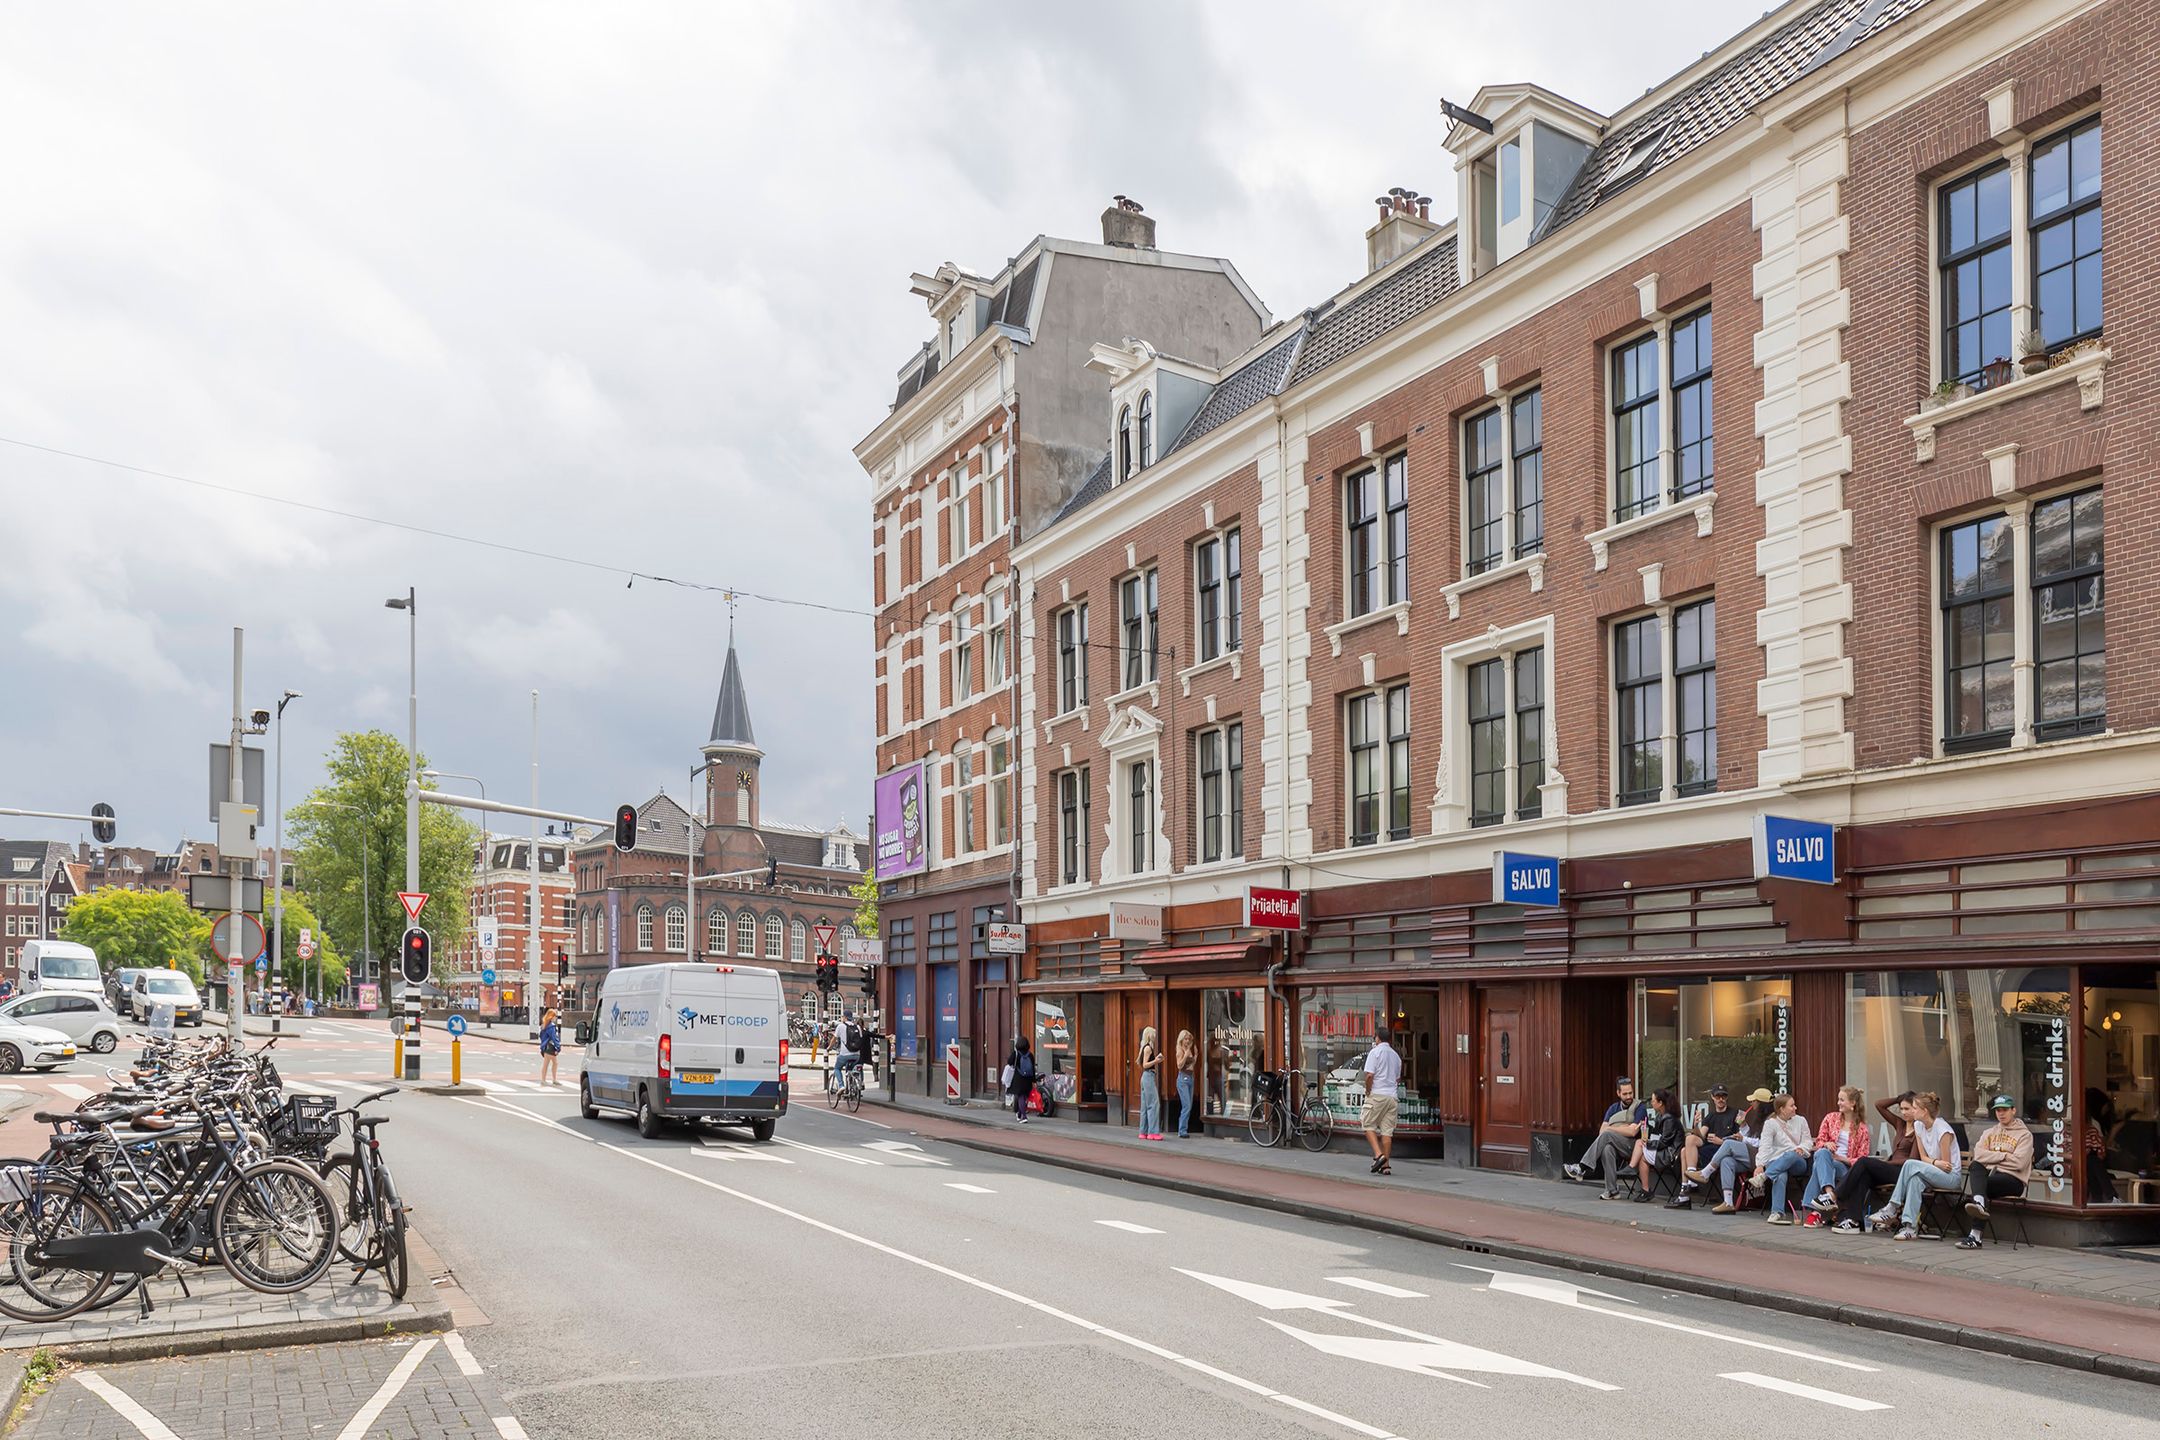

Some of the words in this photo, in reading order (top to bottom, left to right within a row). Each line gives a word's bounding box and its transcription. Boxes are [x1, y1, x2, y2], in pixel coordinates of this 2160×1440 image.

[1777, 837, 1824, 864] SALVO
[1511, 867, 1551, 891] SALVO
[1251, 897, 1300, 917] Prijatelji.nl
[1116, 913, 1132, 924] the
[1133, 915, 1160, 927] salon
[1215, 1024, 1228, 1040] the
[1229, 1025, 1253, 1040] salon
[2046, 1018, 2064, 1088] drinks
[2046, 1093, 2064, 1113] &
[2047, 1119, 2065, 1193] Coffee
